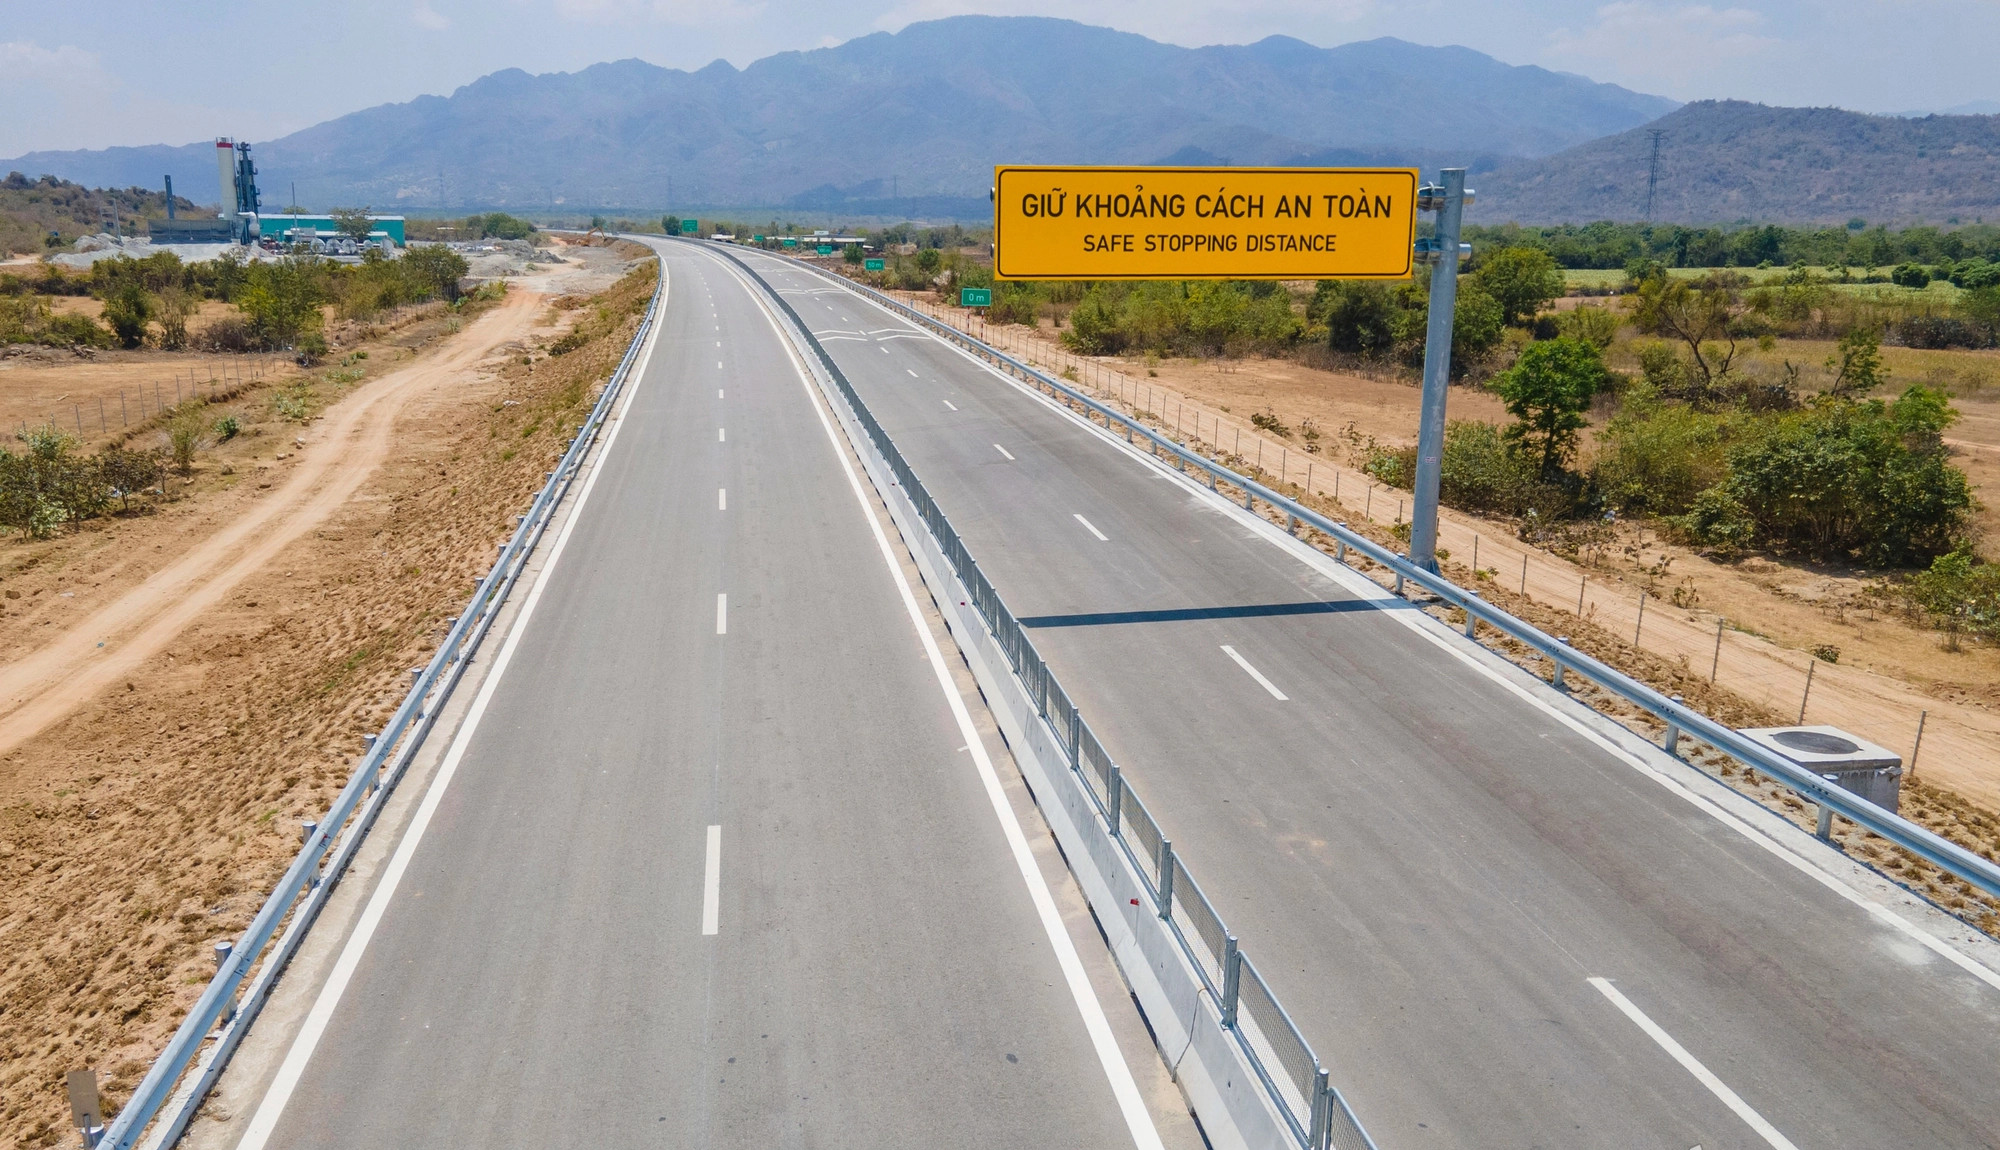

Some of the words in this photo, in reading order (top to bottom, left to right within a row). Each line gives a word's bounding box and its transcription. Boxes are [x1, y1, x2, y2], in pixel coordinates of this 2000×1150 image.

[1021, 187, 1068, 218] GIỮ
[1075, 184, 1186, 218] KHOẢNG
[1195, 186, 1264, 219] CÁCH
[1274, 194, 1312, 219] AN
[1322, 187, 1392, 219] TOÀN
[1083, 234, 1135, 252] SAFE
[1144, 234, 1238, 252] STOPPING
[1246, 234, 1337, 252] DISTANCE
[968, 293, 974, 302] 0
